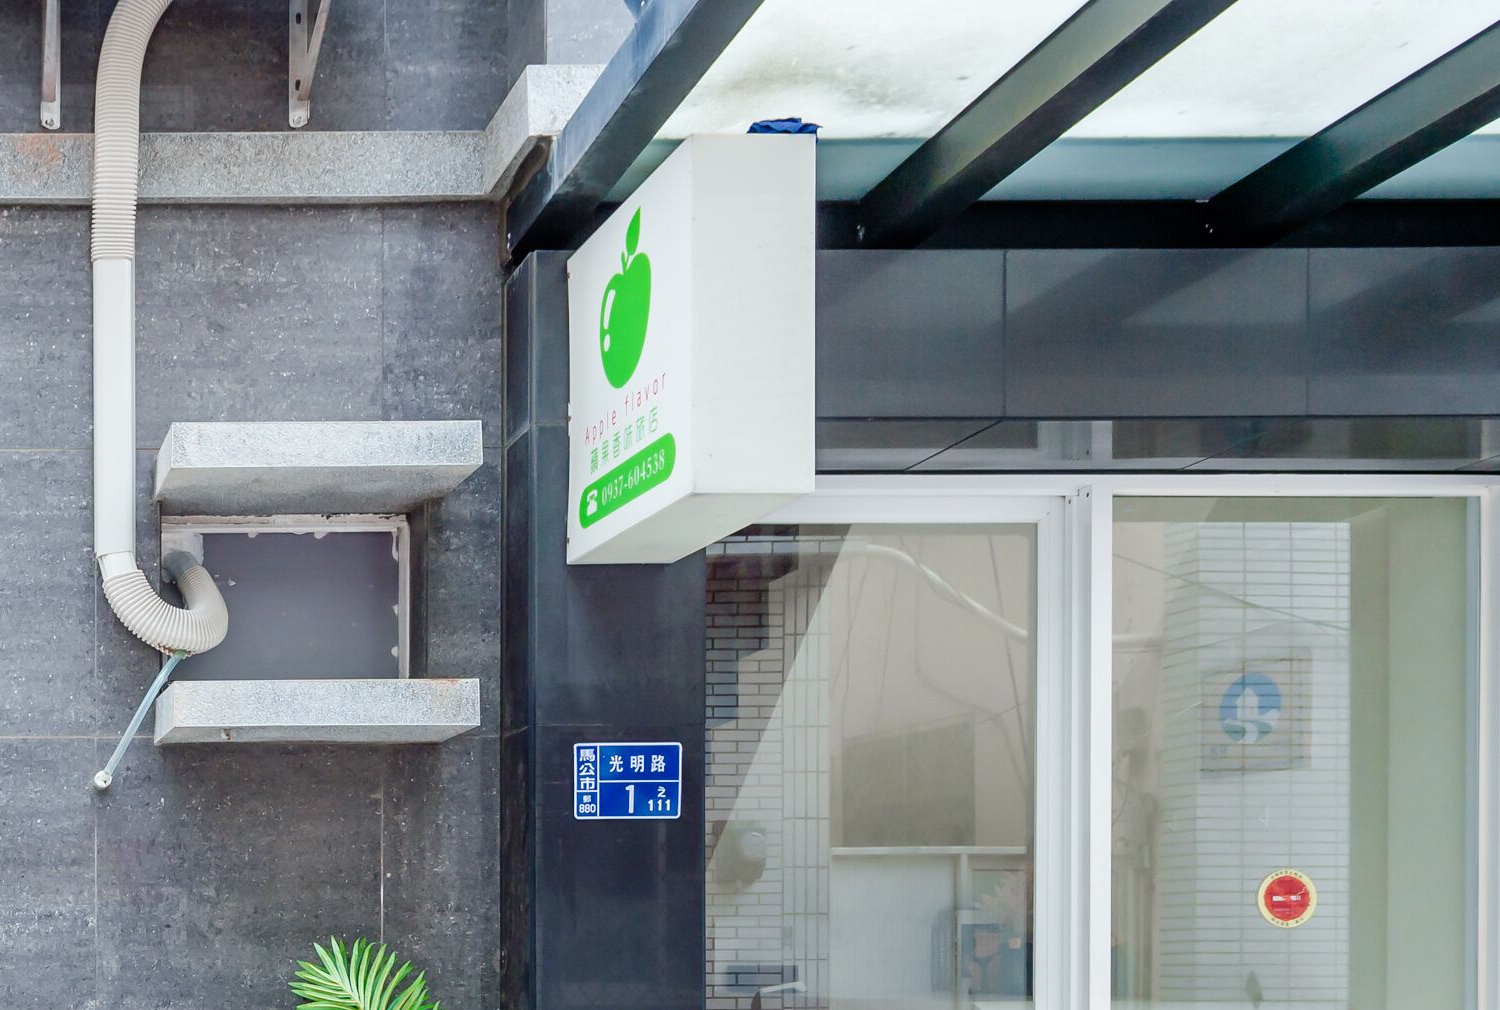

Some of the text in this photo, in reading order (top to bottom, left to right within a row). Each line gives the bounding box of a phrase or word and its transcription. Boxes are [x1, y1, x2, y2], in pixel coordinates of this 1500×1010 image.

[584, 372, 666, 446] Apple flavor
[590, 406, 658, 475] 蘋果香味旅店
[601, 449, 665, 506] 0937-604538
[579, 748, 596, 790] 馬公市
[609, 754, 666, 773] 光明路
[625, 784, 635, 814] 1
[648, 799, 671, 812] 111
[657, 786, 666, 798] 之
[579, 804, 596, 813] 880
